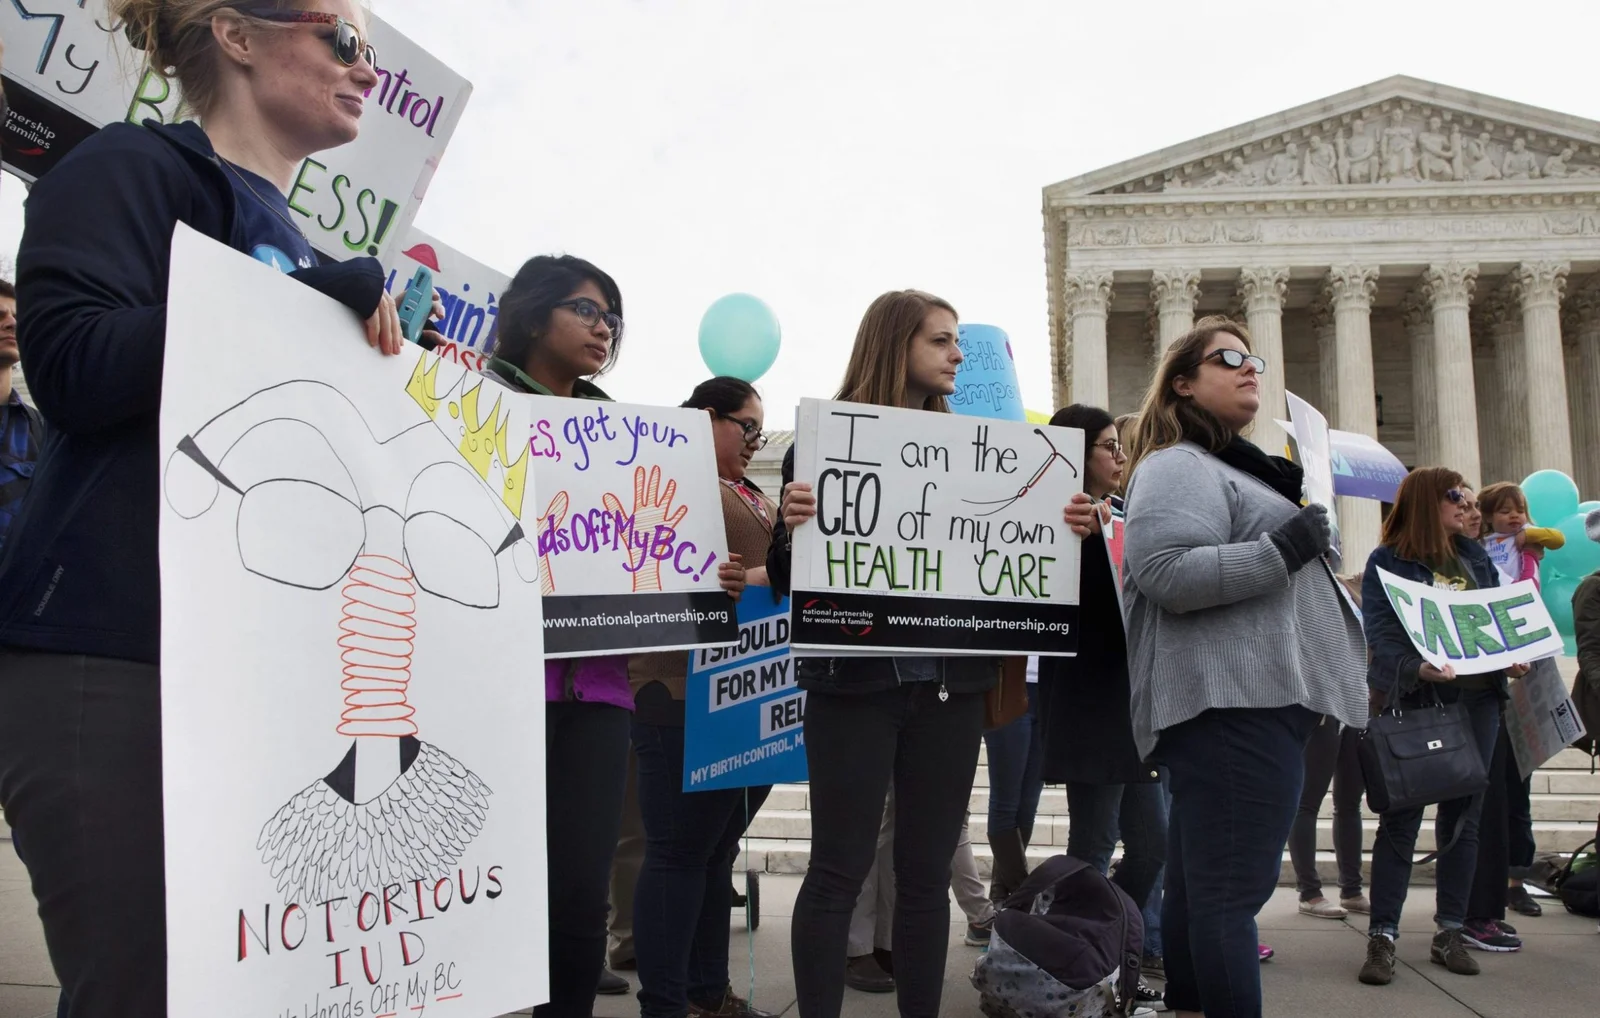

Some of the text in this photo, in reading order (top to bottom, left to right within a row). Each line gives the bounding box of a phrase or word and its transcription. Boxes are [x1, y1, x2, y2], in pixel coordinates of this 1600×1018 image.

[5, 106, 56, 140] tnership
[364, 67, 444, 138] ntrol
[5, 118, 51, 149] families
[288, 156, 400, 257] ESS!
[957, 341, 1005, 374] rth
[947, 381, 1016, 412] empo
[563, 406, 616, 471] get
[615, 415, 688, 466] your
[825, 412, 1018, 474] I am the
[1372, 471, 1402, 485] CENTE
[817, 467, 1055, 565] CEO of my own
[826, 540, 1057, 599] HEALTH CARE
[542, 609, 728, 628] www.nationalpartnership.org
[802, 608, 874, 619] national partnership
[802, 615, 813, 623] for
[814, 617, 840, 625] women
[847, 617, 874, 626] families
[887, 614, 1070, 635] www.nationalpartnership.org
[1385, 583, 1552, 660] CARE
[716, 669, 757, 706] FOR
[760, 658, 791, 692] MY
[770, 697, 804, 732] REL
[690, 766, 708, 786] MY
[710, 752, 742, 779] BIRTH
[743, 737, 794, 766] CONTROL,
[237, 865, 503, 962] NOTORIOUS
[370, 982, 401, 1015] Off
[405, 972, 428, 1018] My
[433, 962, 463, 993] BC
